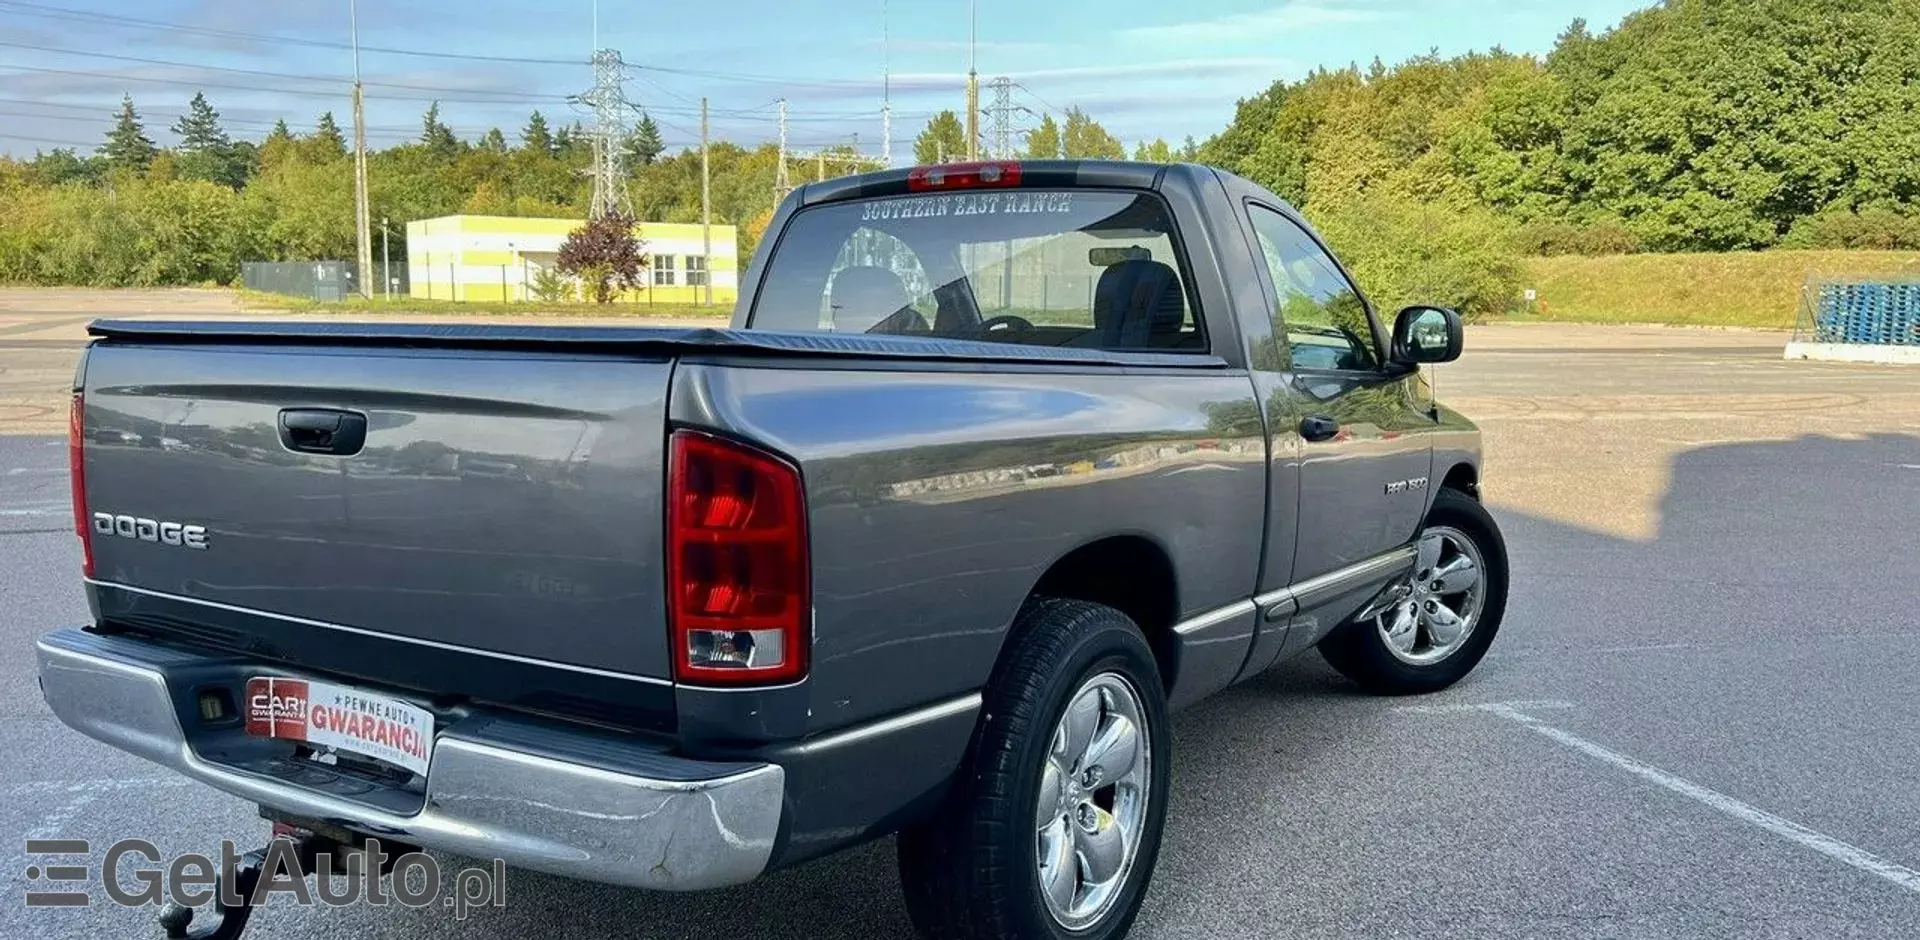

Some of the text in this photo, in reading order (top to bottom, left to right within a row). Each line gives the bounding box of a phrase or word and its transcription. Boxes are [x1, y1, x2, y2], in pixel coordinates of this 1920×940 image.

[861, 192, 1073, 220] SOUTHERN EAST RANCH
[94, 512, 208, 550] DODGE
[345, 695, 409, 724] PEWNE AUTO
[311, 704, 427, 761] GWARANCJA
